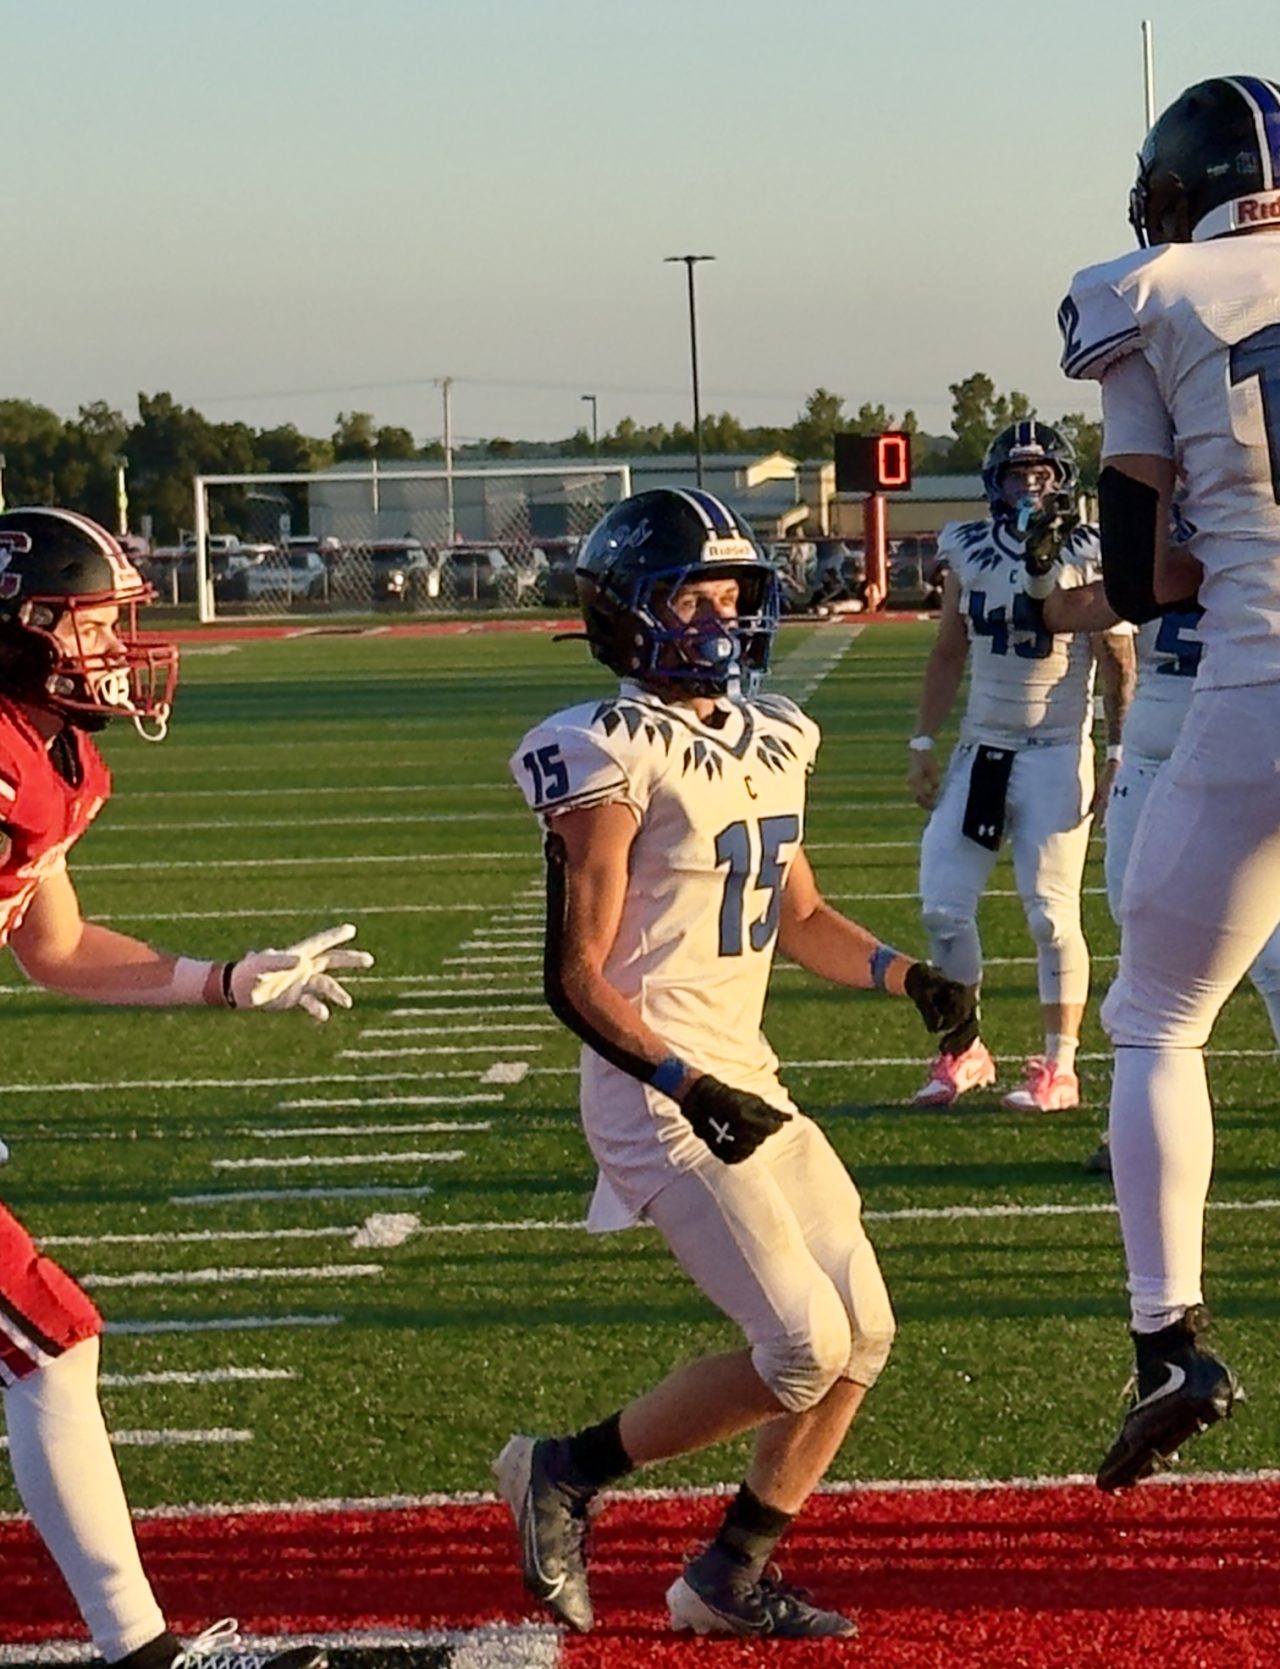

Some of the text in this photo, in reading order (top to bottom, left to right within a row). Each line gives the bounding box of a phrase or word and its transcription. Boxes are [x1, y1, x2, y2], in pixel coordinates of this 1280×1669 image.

[879, 437, 906, 485] 0
[522, 743, 570, 806] 15
[744, 774, 758, 801] C
[714, 813, 800, 958] 15
